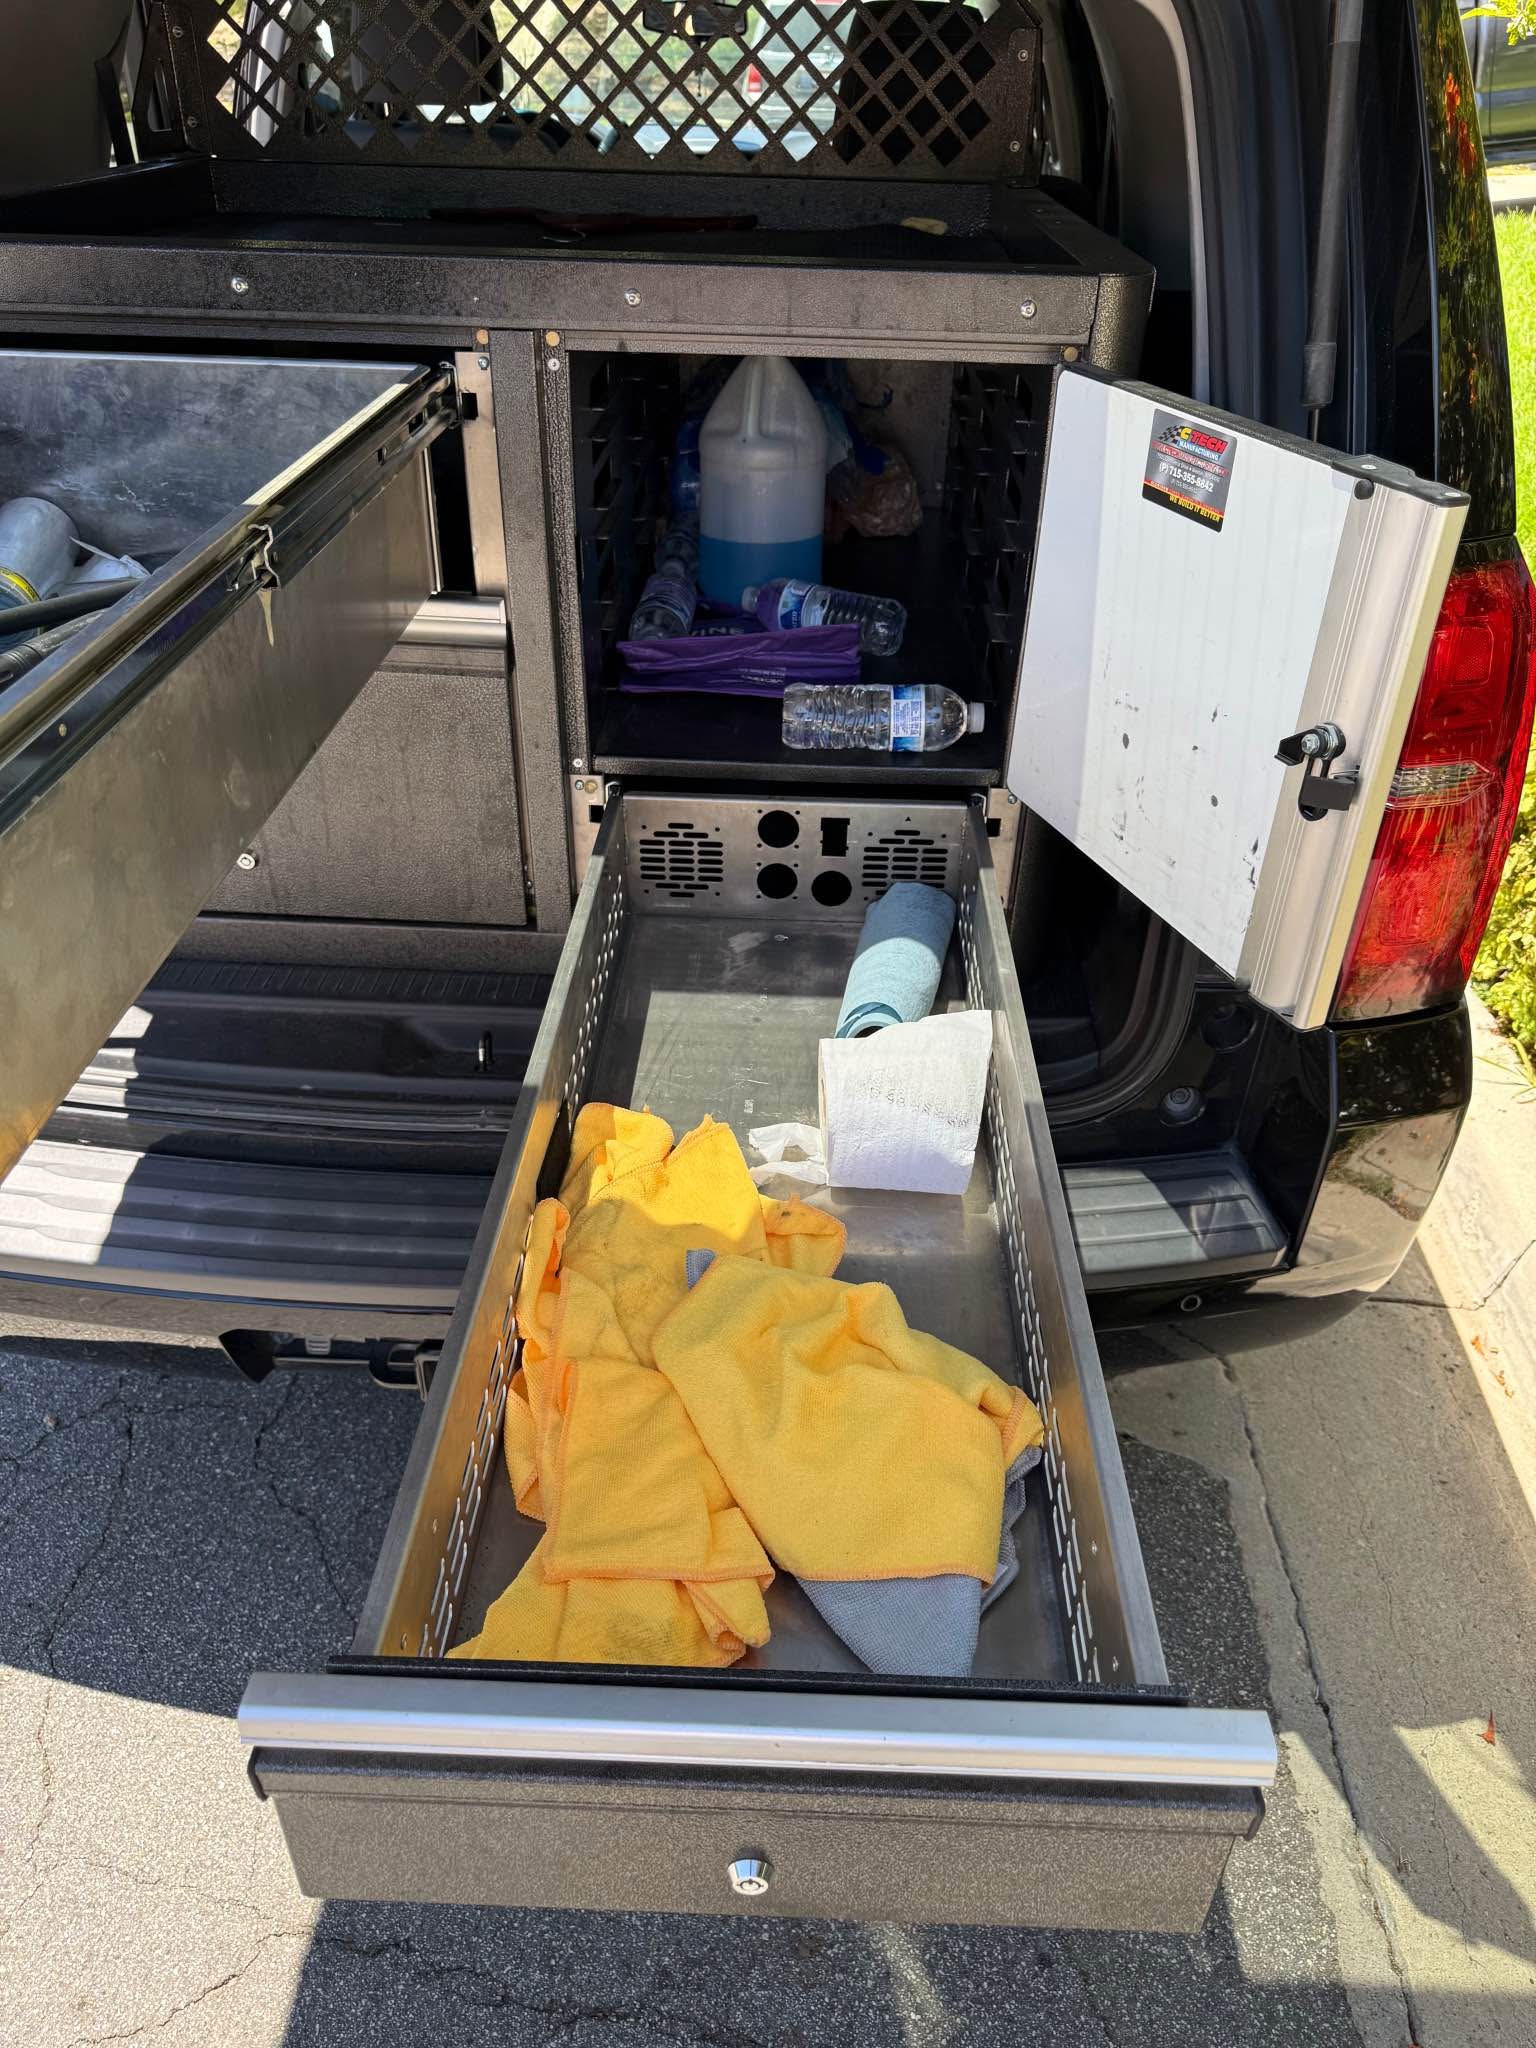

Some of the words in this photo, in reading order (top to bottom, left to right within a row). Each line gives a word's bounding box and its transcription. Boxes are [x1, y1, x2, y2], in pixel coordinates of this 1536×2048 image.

[1179, 440, 1220, 461] MANUFACTURING
[1191, 431, 1228, 454] TECH
[1159, 462, 1169, 473] (P)
[1169, 494, 1177, 504] WE
[1177, 498, 1194, 510] BUILD
[1199, 508, 1220, 522] BETTER
